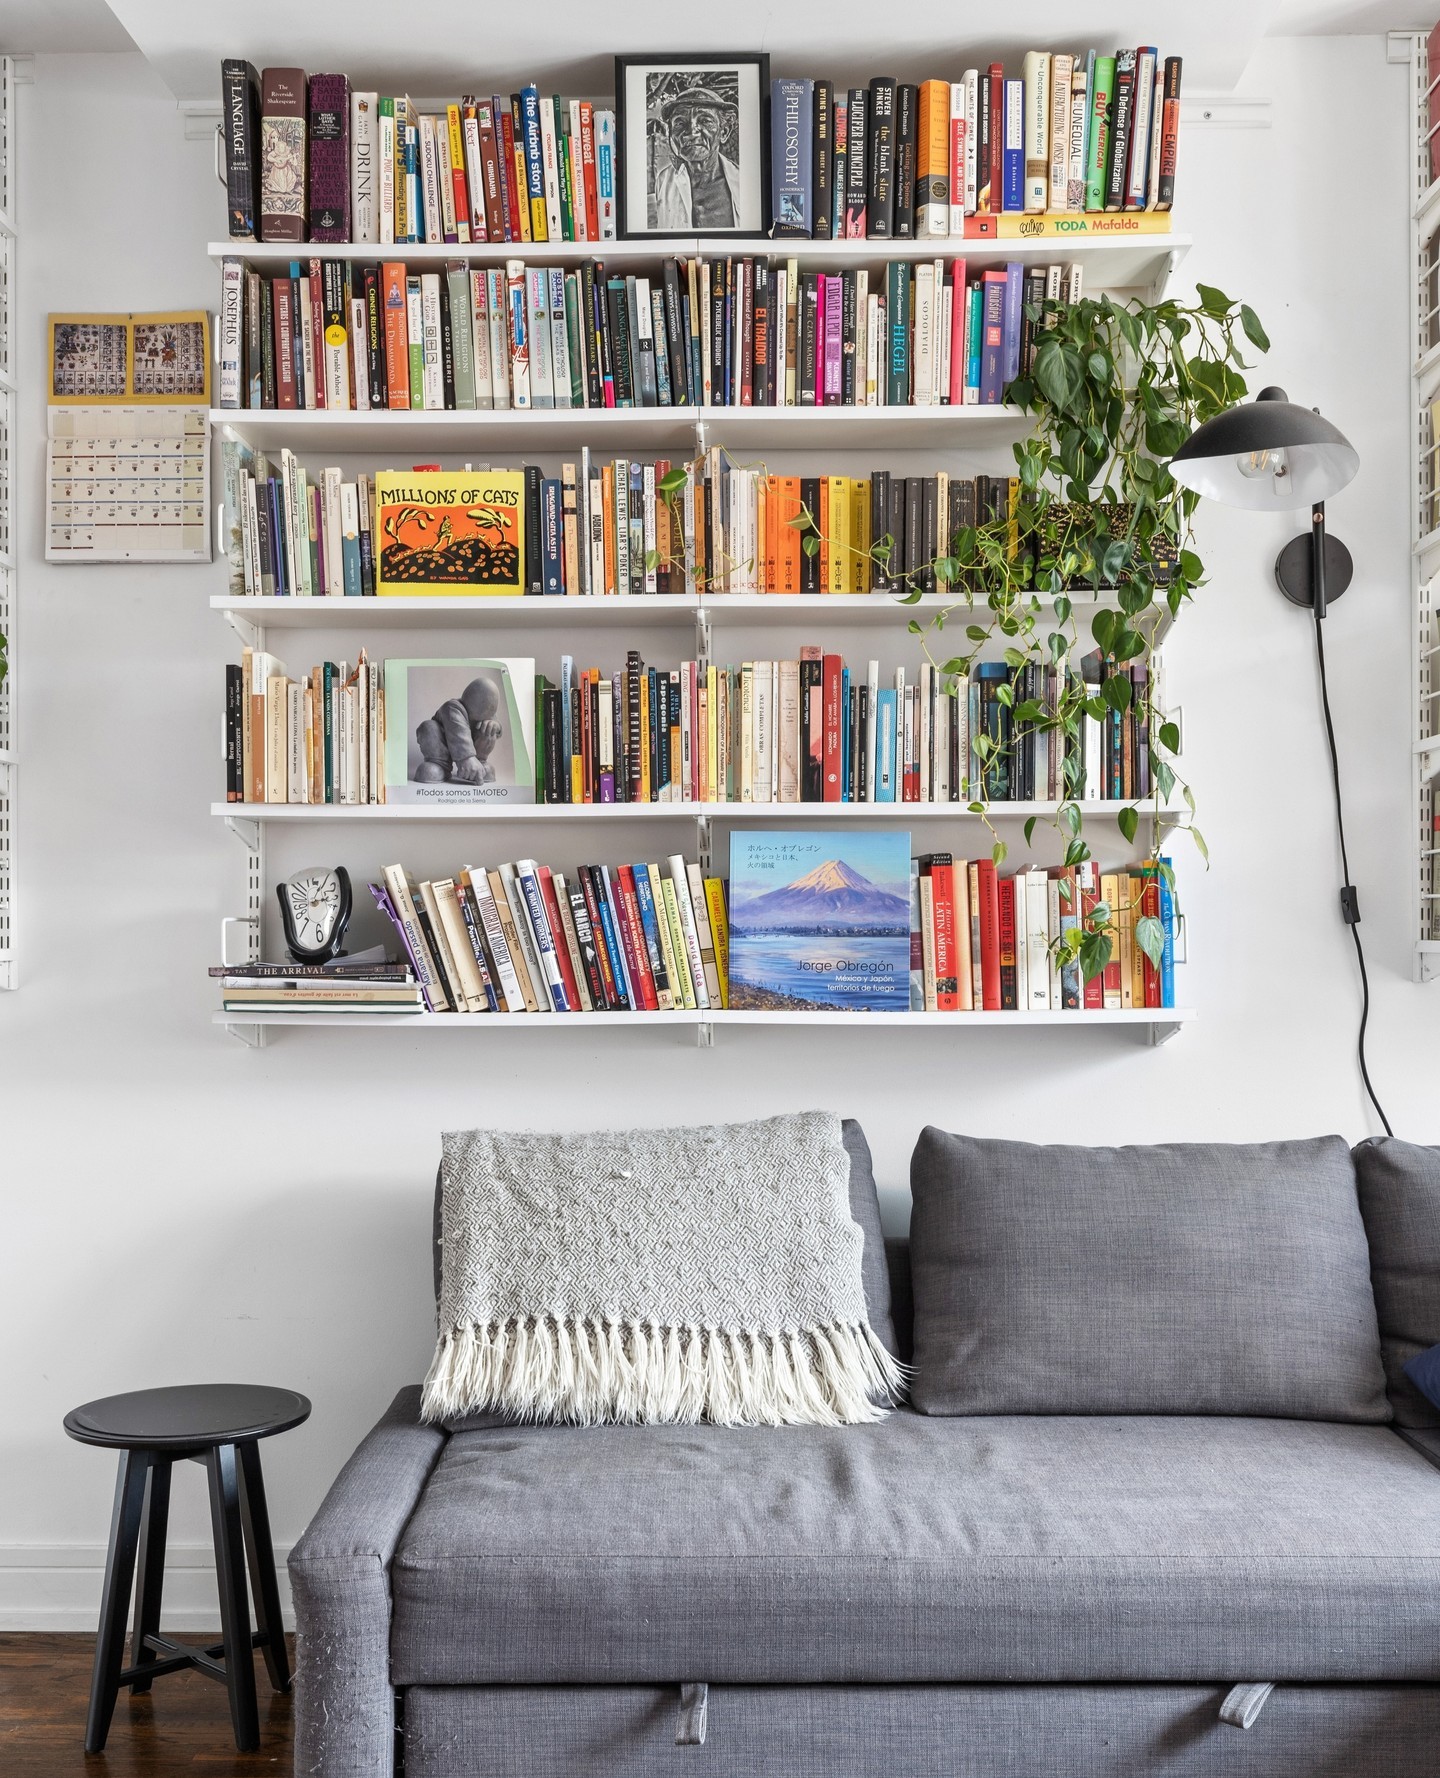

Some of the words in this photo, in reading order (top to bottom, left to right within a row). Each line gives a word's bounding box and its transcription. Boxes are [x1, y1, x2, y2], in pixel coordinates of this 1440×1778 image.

[1036, 71, 1045, 129] Unconquerable
[1120, 86, 1129, 94] In
[526, 96, 536, 117] the
[581, 108, 590, 124] no
[819, 112, 826, 121] TO
[851, 101, 864, 138] LUCIFER
[969, 110, 974, 119] OF
[1095, 92, 1106, 119] BUY
[1117, 96, 1129, 128] Defense
[231, 86, 244, 155] LANGUAGE
[465, 122, 477, 146] Beer
[835, 107, 846, 154] BLOWBACK
[880, 126, 890, 141] the
[1071, 108, 1082, 160] UNEQUAL
[1116, 130, 1126, 139] of
[424, 140, 432, 169] SUDOKU
[527, 120, 540, 160] Airbnb
[574, 137, 582, 167] Pedaling
[583, 127, 594, 164] sweat
[785, 96, 799, 185] PHILOSOPHY
[1036, 132, 1044, 155] World
[1096, 122, 1106, 169] AMERICAN
[356, 142, 371, 204] DRINK
[384, 159, 392, 173] POOL
[850, 140, 864, 187] PRINCIPLE
[879, 145, 890, 173] blank
[1112, 141, 1125, 192] Globalization
[397, 172, 406, 201] Investing
[426, 170, 435, 207] CHALLENGE
[486, 160, 496, 199] CHIHUAHUA
[530, 162, 541, 194] story
[879, 178, 889, 202] slate
[383, 182, 392, 213] BILLIARDS
[1054, 221, 1088, 231] TODA
[1092, 219, 1140, 230] Mafalda
[279, 295, 288, 320] PATTERNS
[652, 292, 662, 307] Eros
[827, 282, 840, 312] EDGAR
[988, 286, 1000, 323] PHILOSOPHY
[226, 288, 237, 345] JOSEPHUS
[654, 308, 662, 320] and
[755, 308, 766, 320] EL
[281, 327, 290, 360] COMPARATIVE
[655, 320, 665, 356] Civilization
[755, 322, 766, 365] TRAIDOR
[828, 322, 840, 337] POE
[461, 328, 469, 373] RELIGIONS
[892, 324, 905, 376] HEGEL
[283, 361, 291, 383] RELIGION
[617, 463, 626, 496] MICHAEL
[380, 488, 456, 505] MILLIONS
[460, 490, 480, 504] OF
[482, 490, 520, 506] CATS
[548, 486, 556, 536] BHAGAVAD-GITA
[550, 537, 557, 546] AS
[619, 553, 628, 577] POKER
[629, 661, 639, 704] STELLA
[743, 675, 751, 714] Jicoténcal
[630, 712, 640, 779] MANHATTAN
[416, 788, 444, 796] #Todos
[473, 788, 508, 797] TIMOTEO
[747, 844, 821, 852] ホルヘ・オブレゴン
[525, 880, 534, 892] WE
[570, 894, 583, 906] EL
[528, 892, 540, 918] WANTED
[936, 901, 945, 929] LATIN
[1001, 885, 1012, 927] HERNANDO
[478, 895, 501, 937] IMMIGRANT
[491, 936, 510, 967] AMERICA
[535, 918, 549, 950] WORKERS
[575, 909, 592, 943] MARCO
[1002, 930, 1012, 939] DE
[1163, 911, 1172, 932] CUBAN
[597, 940, 608, 960] NARCOS
[687, 935, 698, 959] David
[693, 963, 703, 988] Lida
[937, 931, 947, 973] AMERICA
[1002, 941, 1012, 961] SOTO
[1164, 934, 1172, 972] REVOLUTION
[257, 968, 280, 976] THE
[281, 966, 326, 975] ARRIVAL
[602, 961, 612, 983] GRINGOS
[796, 960, 832, 974] Jorge
[836, 960, 894, 974] Obregón
[835, 974, 862, 982] México
[869, 974, 895, 984] Japón,
[828, 984, 860, 992] territorios
[861, 984, 872, 992] de
[872, 984, 895, 993] fuego
